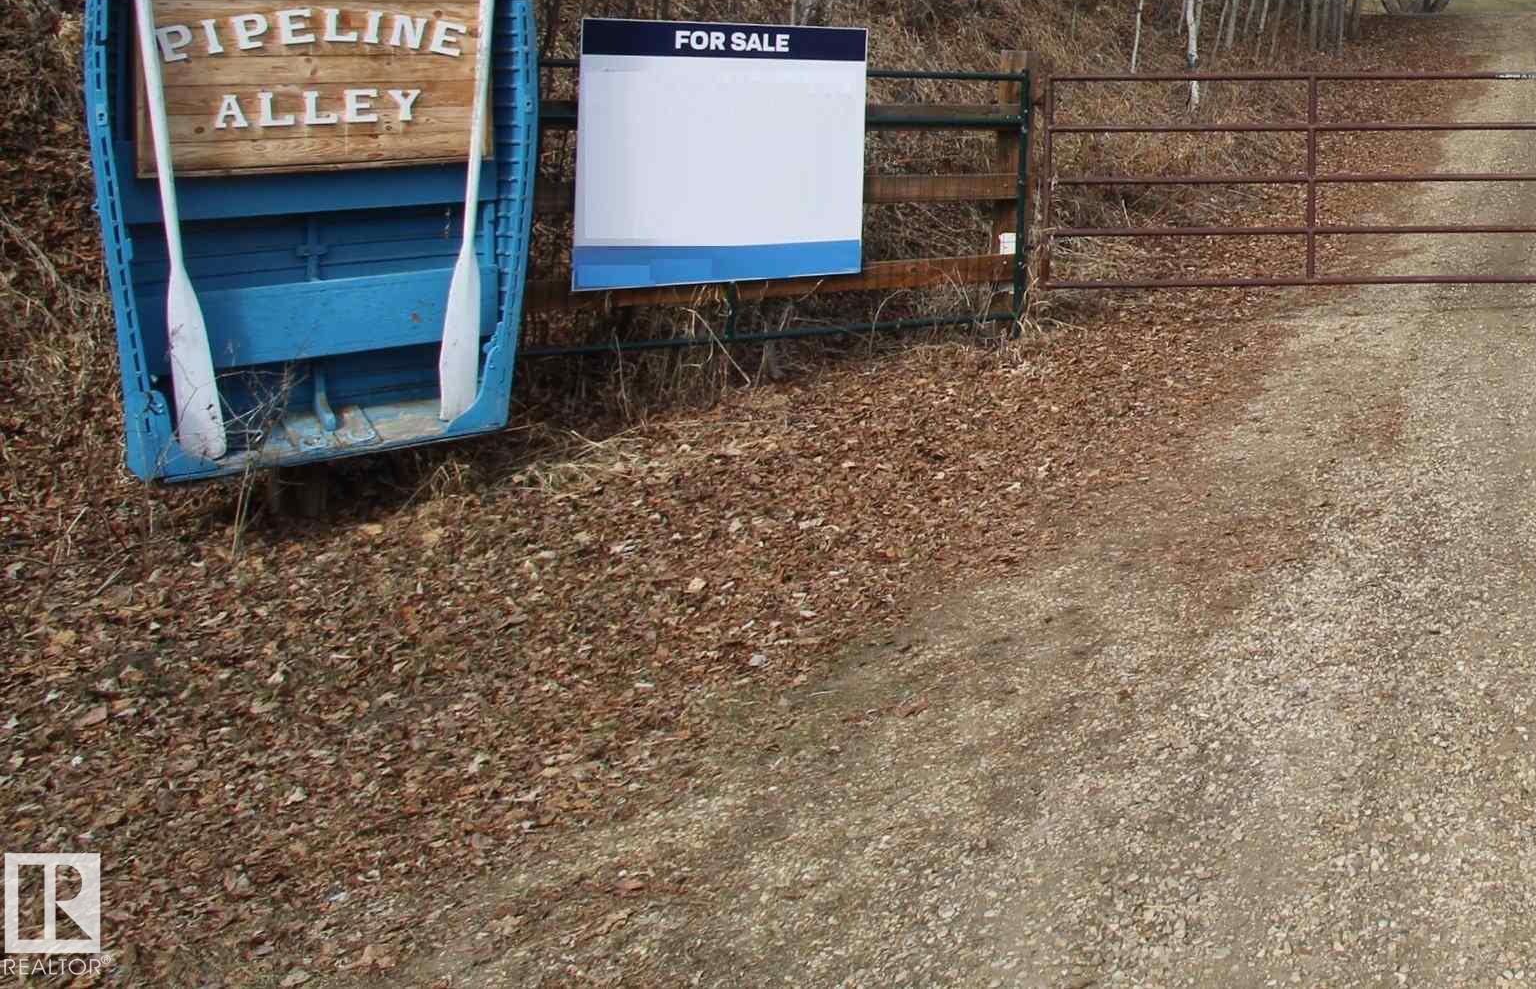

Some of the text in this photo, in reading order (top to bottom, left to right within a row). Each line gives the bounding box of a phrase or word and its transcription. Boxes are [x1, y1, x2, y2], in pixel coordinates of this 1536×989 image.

[155, 7, 467, 62] PIPELINE
[674, 30, 790, 52] FOR SALE
[214, 88, 422, 130] ALLEY
